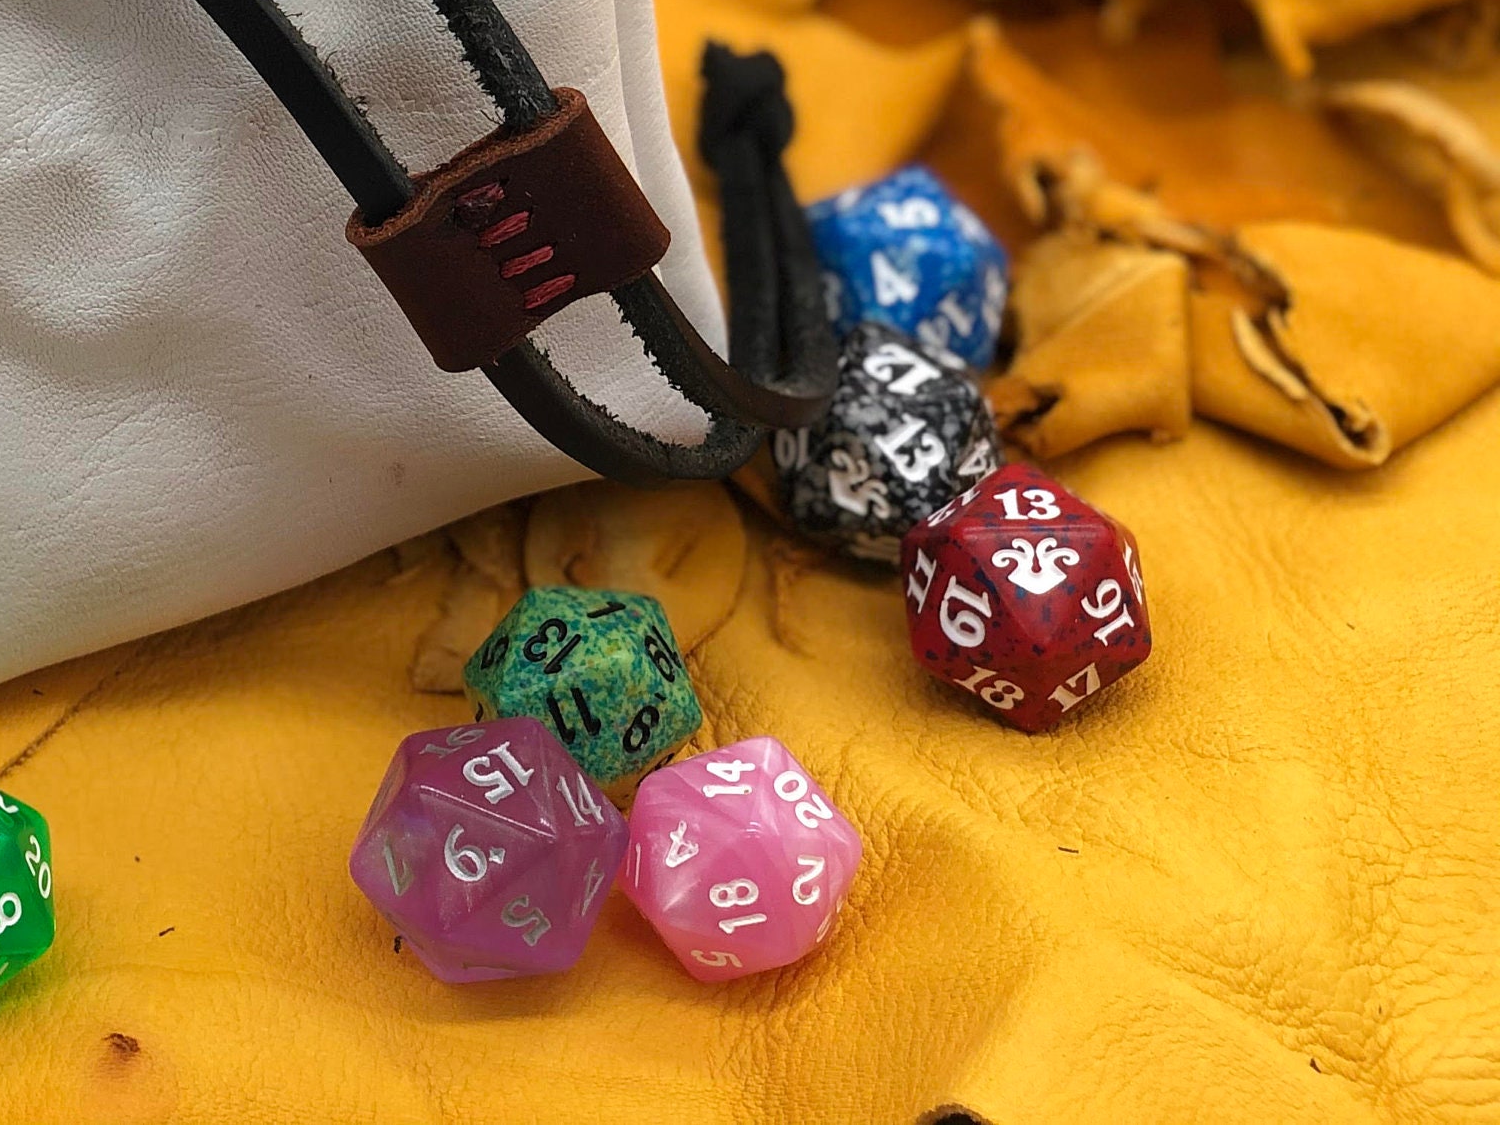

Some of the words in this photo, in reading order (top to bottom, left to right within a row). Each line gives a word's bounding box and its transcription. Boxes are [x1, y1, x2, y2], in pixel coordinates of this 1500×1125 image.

[863, 343, 941, 395] 12
[873, 413, 946, 482] 13
[927, 487, 981, 527] 12
[993, 488, 1061, 521] 13
[907, 548, 938, 615] 11
[939, 575, 993, 649] 19
[1081, 578, 1135, 647] 16
[523, 617, 582, 674] 13
[954, 665, 1025, 711] 18
[1047, 662, 1101, 713] 17
[546, 687, 602, 745] 11
[462, 741, 535, 804] 15
[556, 773, 605, 827] 14
[702, 759, 755, 798] 14
[773, 770, 834, 829] 20
[25, 835, 52, 899] 20
[665, 820, 700, 868] 4
[709, 878, 767, 935] 18
[792, 855, 825, 906] 2
[500, 894, 552, 947] 5
